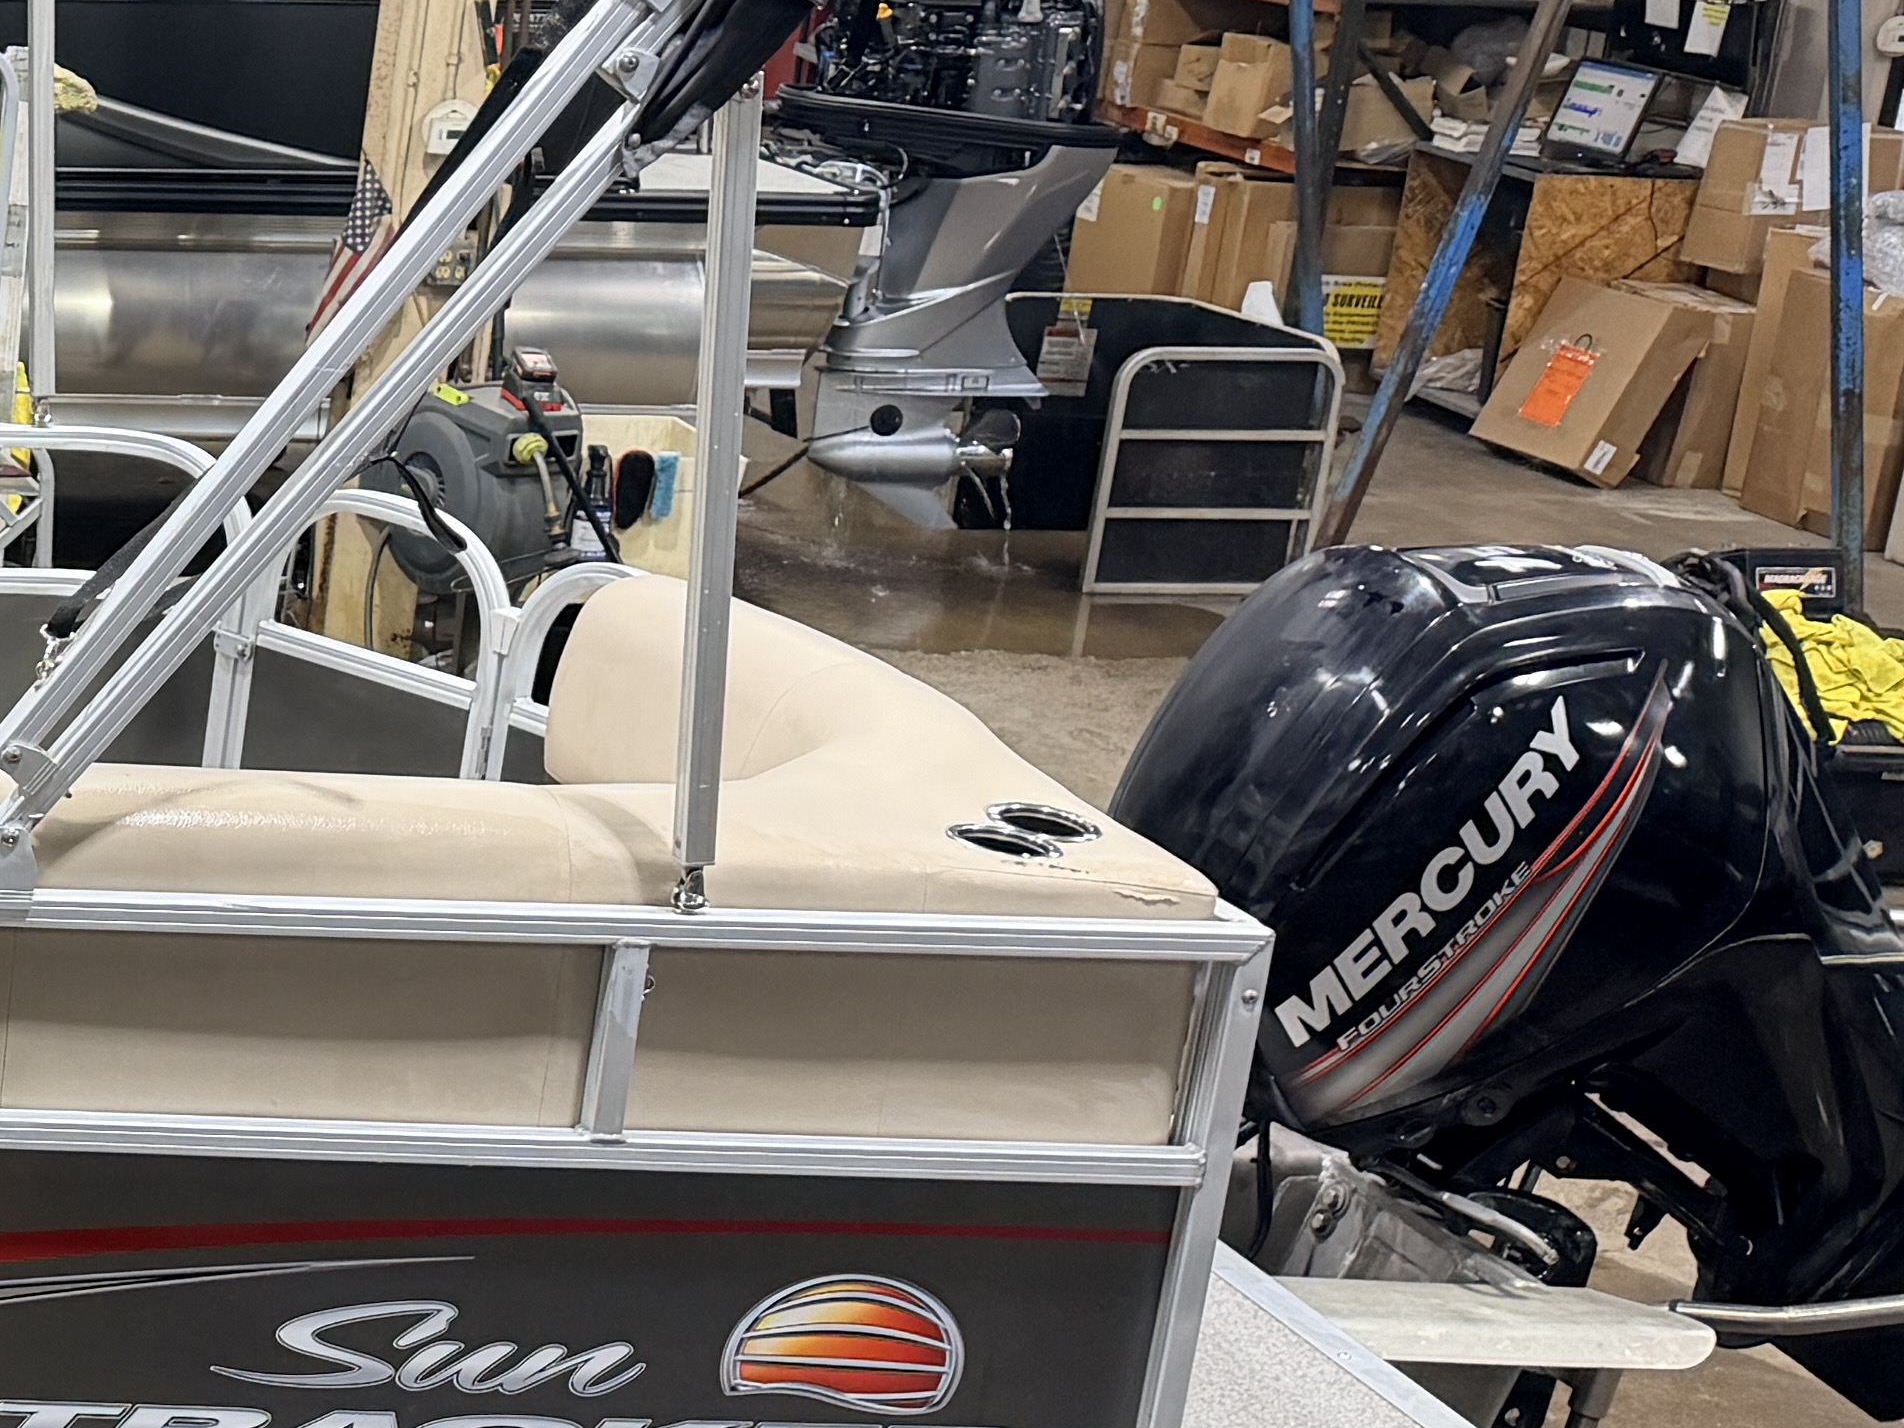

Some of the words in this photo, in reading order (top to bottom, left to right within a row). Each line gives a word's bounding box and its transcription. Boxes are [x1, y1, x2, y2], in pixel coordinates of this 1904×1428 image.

[1274, 694, 1581, 1049] MERCURY
[1335, 860, 1534, 1052] FOURSTROKE
[209, 1299, 647, 1398] Sun
